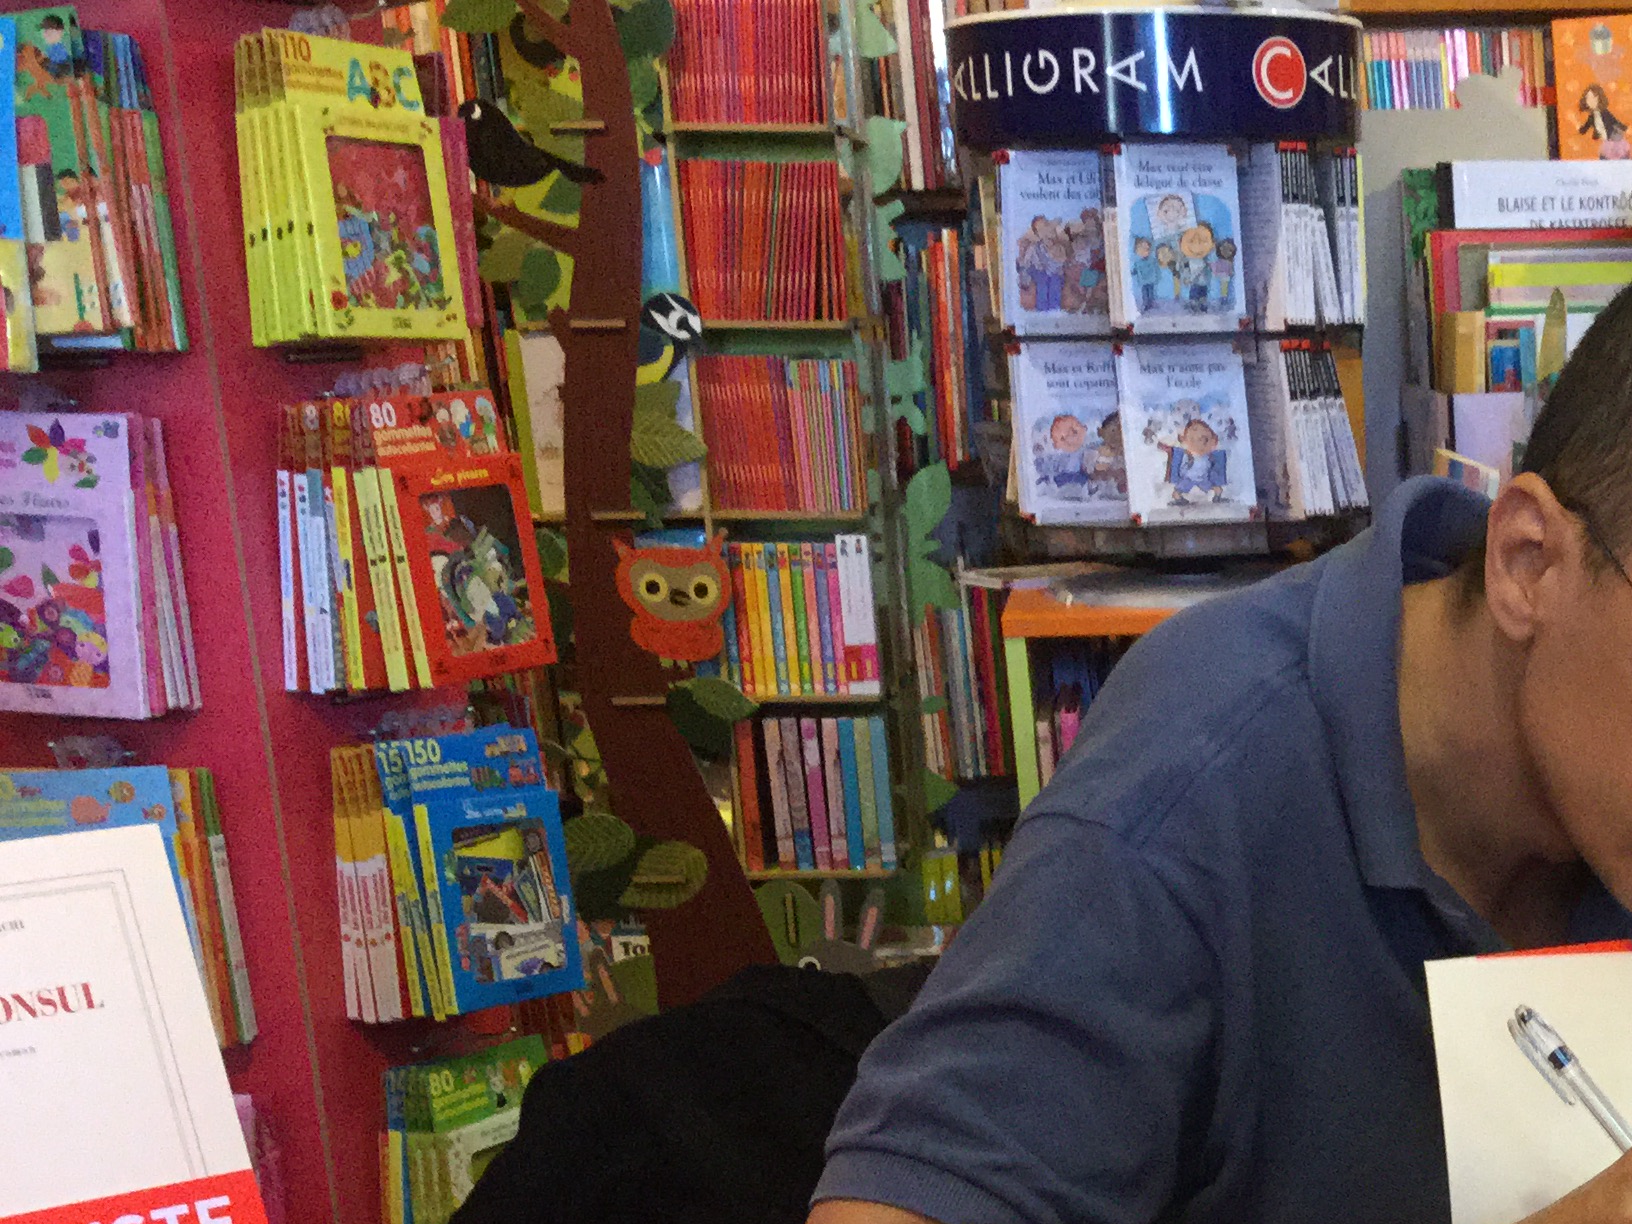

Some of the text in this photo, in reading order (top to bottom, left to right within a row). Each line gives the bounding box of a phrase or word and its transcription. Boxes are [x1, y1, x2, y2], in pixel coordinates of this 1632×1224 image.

[347, 57, 419, 111] ABC
[1498, 195, 1537, 213] BLAISE
[1542, 196, 1555, 212] ET
[1561, 195, 1575, 212] LE
[370, 401, 396, 428] 80
[402, 738, 441, 766] 150
